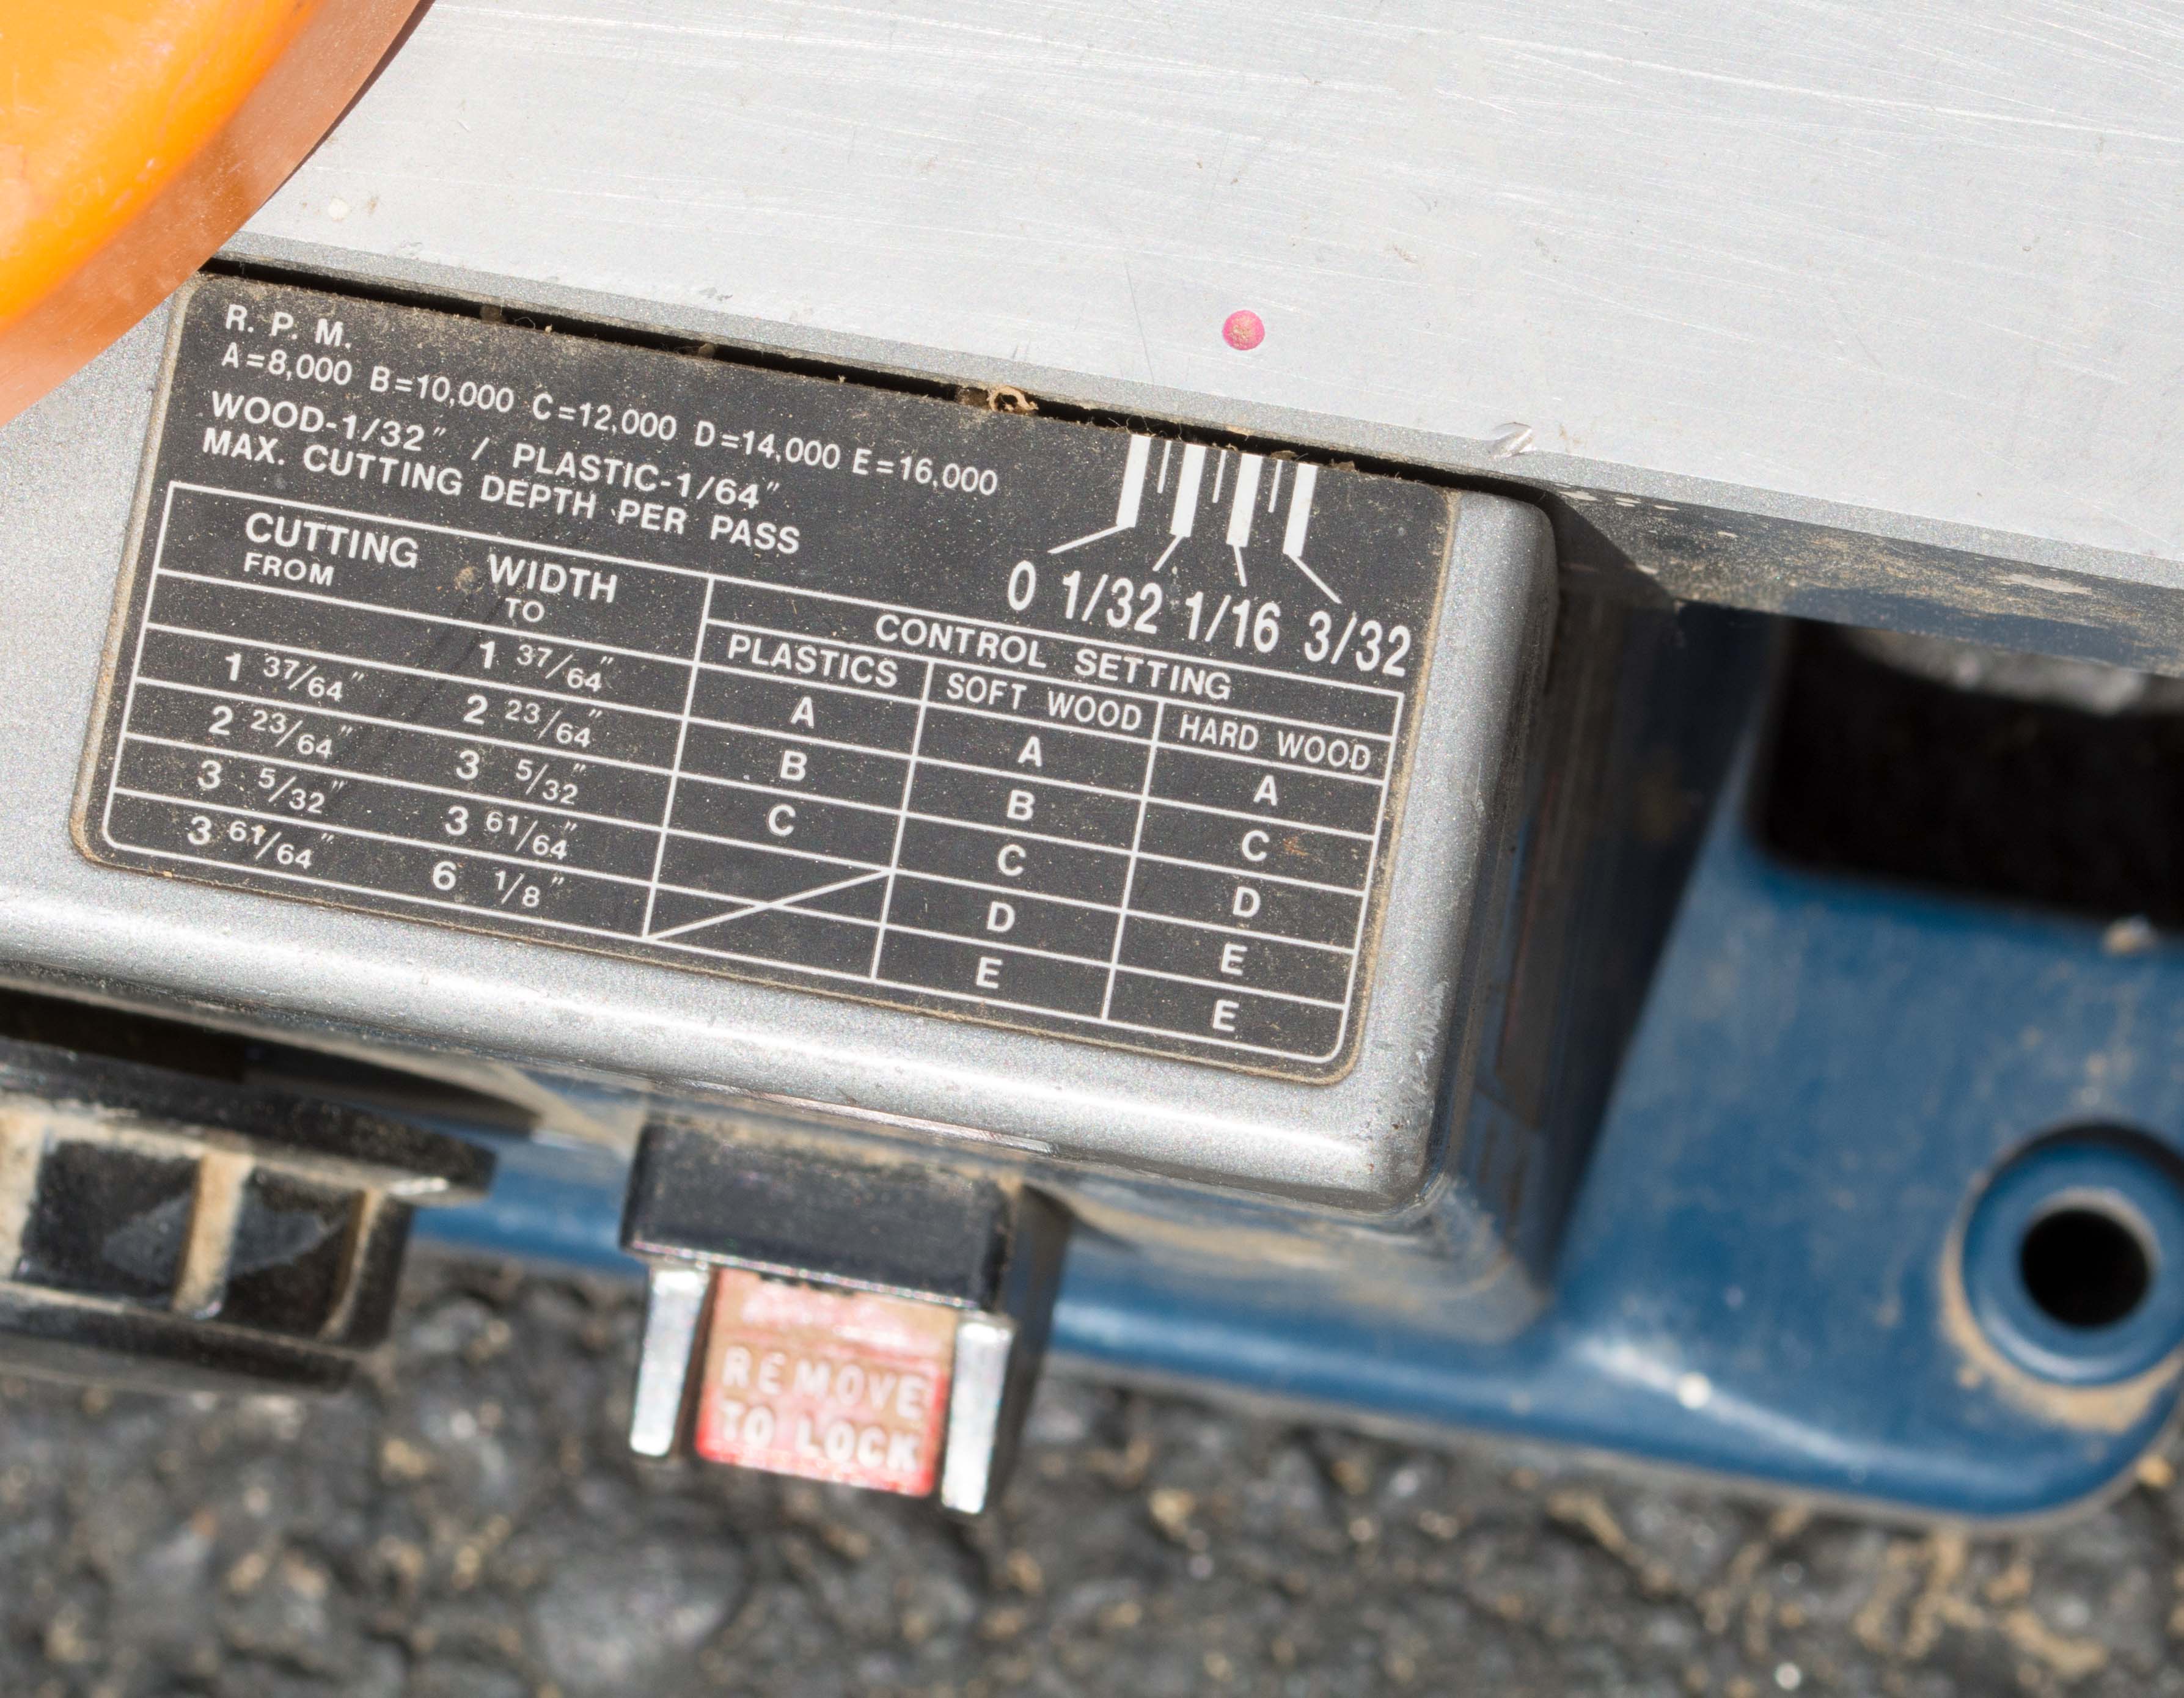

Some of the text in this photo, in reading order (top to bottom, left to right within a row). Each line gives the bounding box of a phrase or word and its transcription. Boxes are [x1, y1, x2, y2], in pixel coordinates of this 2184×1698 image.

[225, 304, 351, 349] R. P. M.
[471, 437, 490, 461] /
[202, 427, 800, 554] MAX. CUTTING DEPTH PER PASS
[244, 552, 334, 586] FROM
[246, 512, 618, 603] CUTTING WIDTH
[505, 597, 545, 623] TO
[1007, 560, 1411, 677] 0 1/32 1/16 3/32
[225, 652, 242, 681] 1
[479, 640, 496, 669] 1
[728, 633, 898, 688] PLASTICS
[875, 613, 1231, 700] CONTROL SETTING
[463, 693, 488, 725] 2
[790, 696, 815, 728] A
[947, 672, 1142, 731] SOFT WOOD
[208, 705, 233, 736] 2
[1017, 736, 1042, 767] A
[1179, 714, 1371, 771] HARD WOOD
[197, 759, 222, 791] 3
[456, 749, 480, 780] 3
[780, 750, 807, 781] B
[1006, 789, 1035, 821] B
[1253, 775, 1278, 806] A
[187, 815, 212, 846] 3
[444, 805, 469, 836] 3
[768, 804, 796, 836] C
[997, 844, 1026, 876] C
[1241, 829, 1270, 862] C
[432, 860, 456, 891] 6
[986, 901, 1015, 932] D
[1232, 886, 1261, 918] D
[975, 956, 1003, 989] E
[1220, 942, 1248, 976] E
[1212, 999, 1239, 1032] E
[722, 1347, 927, 1416] REMOVE
[721, 1400, 919, 1471] TO LOCK
